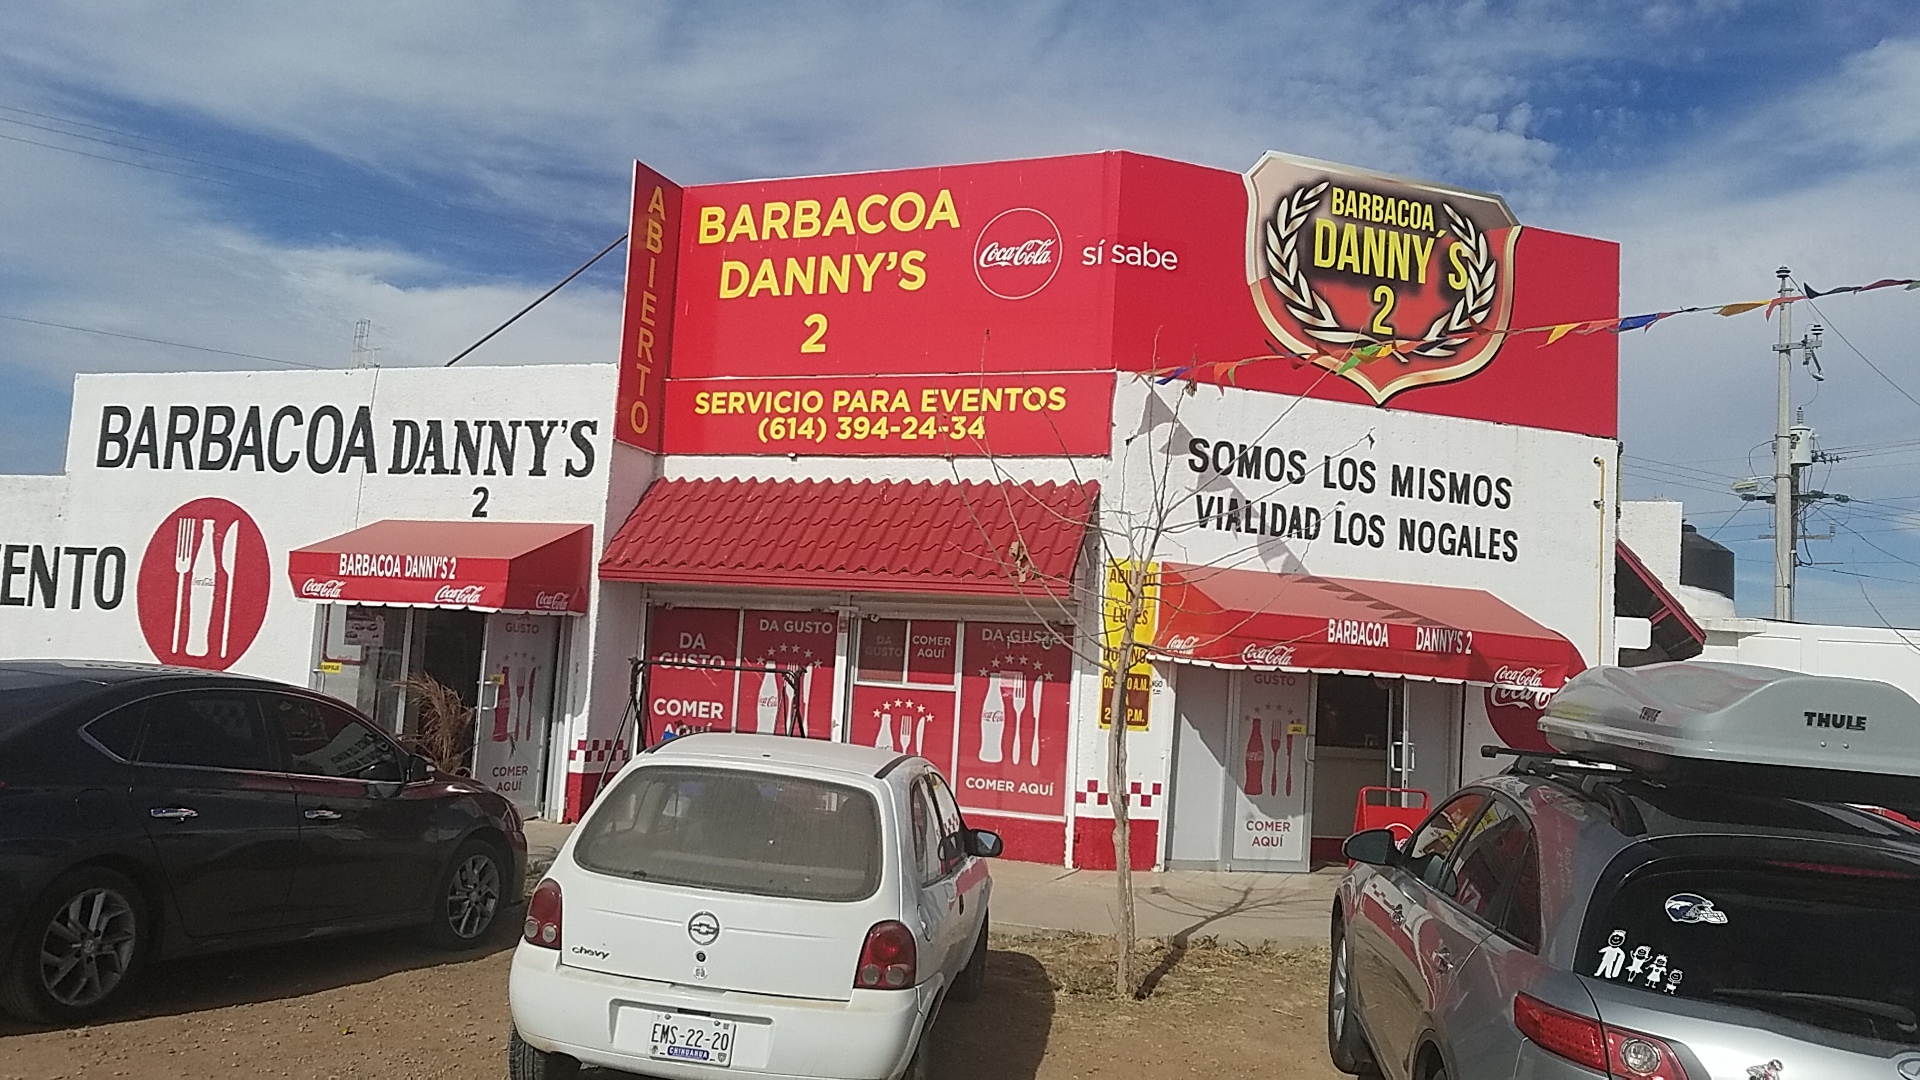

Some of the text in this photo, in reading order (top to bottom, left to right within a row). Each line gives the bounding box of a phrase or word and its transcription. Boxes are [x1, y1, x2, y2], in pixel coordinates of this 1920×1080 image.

[698, 189, 960, 244] BARBACOA
[1332, 187, 1434, 231] BARBACOA
[980, 239, 1056, 268] Coca-Cola
[1082, 240, 1177, 270] sí sabe
[718, 250, 927, 299] DANNY'S
[630, 185, 665, 434] ABIERTO
[1372, 286, 1395, 335] 2
[801, 314, 828, 353] 2
[694, 386, 1066, 416] SERVICIO PARA EVENTOS
[758, 415, 985, 443] (614) 394-24-34
[96, 405, 598, 478] BARBACOA DANNY'S
[1188, 437, 1512, 509] SOMOS LOS MISMOS
[472, 486, 489, 518] 2
[1196, 495, 1518, 562] VIALIDAD LOS NOGALES
[0, 544, 126, 610] ENTO
[339, 554, 456, 579] BARBACOA DANNY'S 2
[302, 578, 346, 598] Coca-Cola
[435, 585, 486, 603] Coca-Cola
[536, 591, 569, 610] Coca-Cola
[505, 622, 539, 634] GUSTO
[759, 619, 833, 635] DA GUSTO
[982, 628, 1065, 645] DA GUSTO
[1328, 619, 1472, 655] BARBACOA DANNY'S 2
[679, 633, 706, 649] DA
[912, 635, 951, 646] COMER
[659, 652, 725, 671] GUSTO
[917, 646, 945, 659] AQUÍ
[1242, 643, 1296, 665] Coca-Cola
[1254, 673, 1296, 686] GUSTO
[1494, 665, 1545, 686] Coca-Cola
[654, 698, 723, 719] COMER
[1804, 711, 1867, 731] THULE
[492, 766, 528, 778] COMER
[966, 777, 1054, 797] COMER AQUÍ
[1246, 820, 1290, 833] COMER
[1252, 834, 1284, 848] AQUÍ
[571, 945, 610, 960] chevy
[651, 1022, 729, 1051] EMS-22-20
[669, 1047, 708, 1059] CHIHUAHUA
